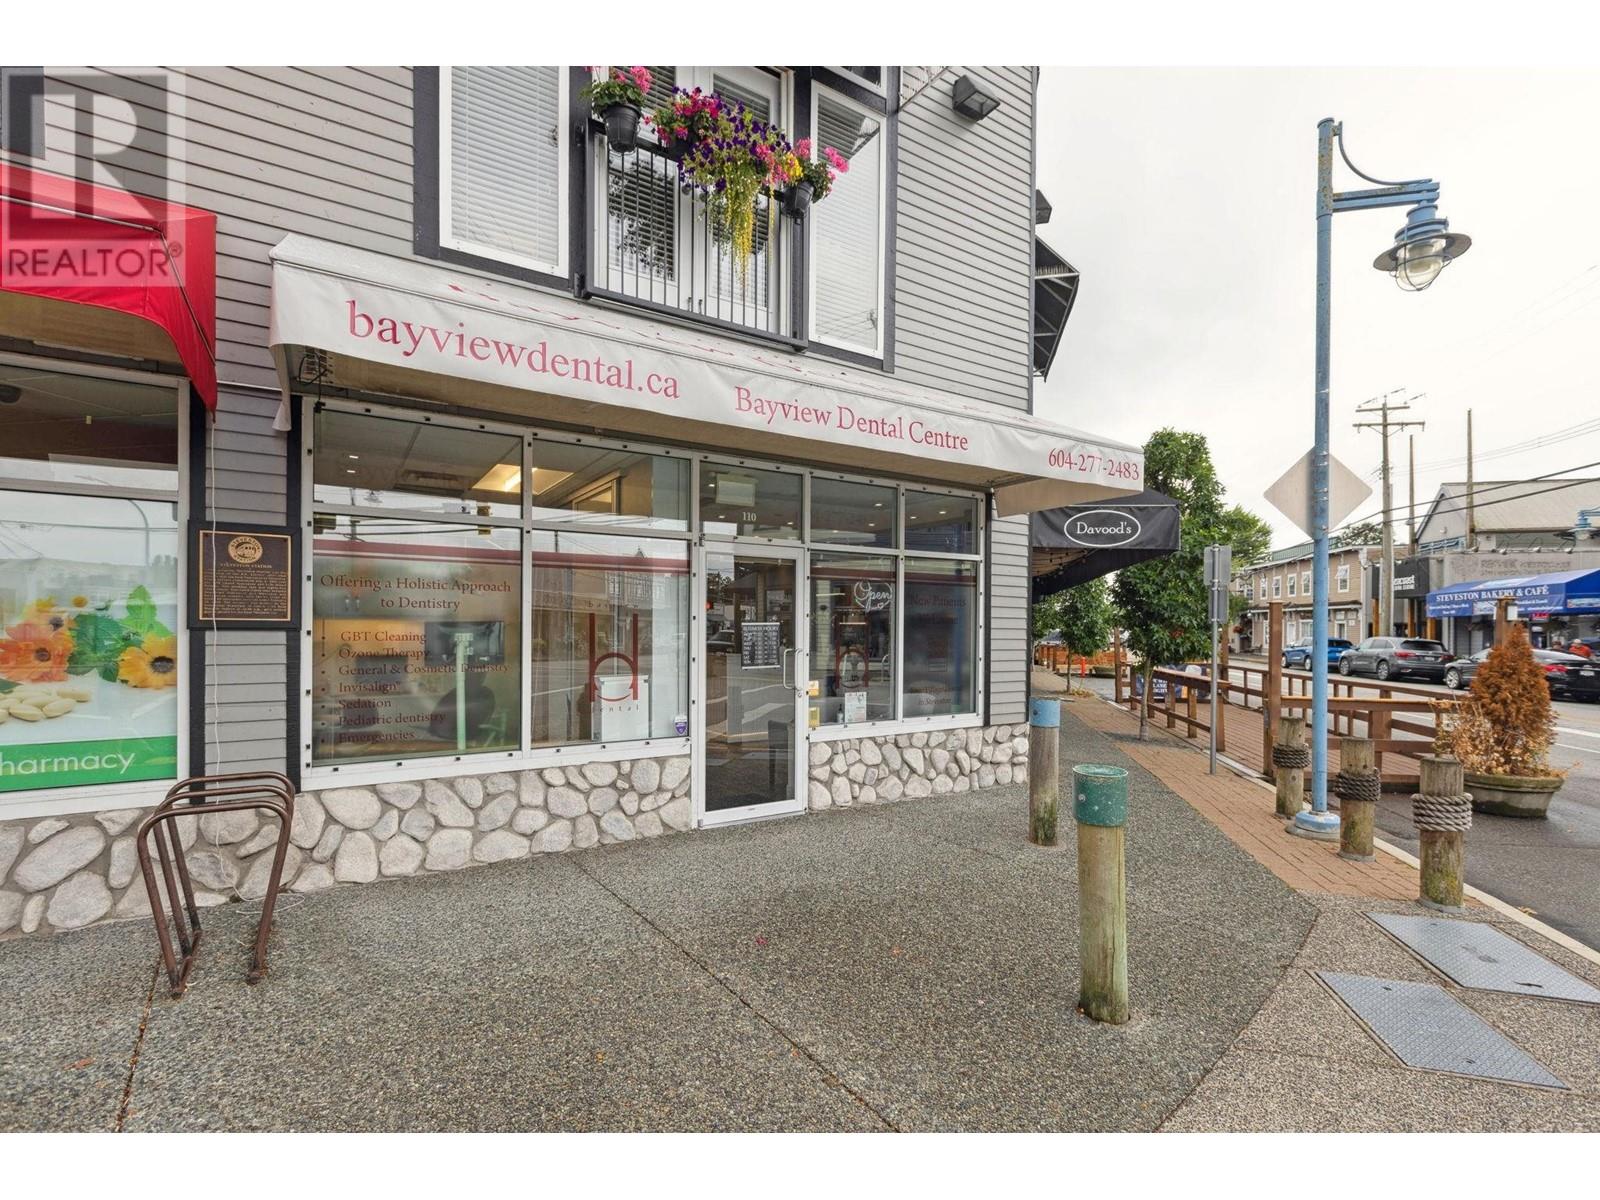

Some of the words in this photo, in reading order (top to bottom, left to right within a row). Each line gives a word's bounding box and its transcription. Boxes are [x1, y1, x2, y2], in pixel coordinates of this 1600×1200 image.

[347, 299, 681, 400] bayviewdental.ca
[735, 386, 832, 424] Bayview
[837, 405, 904, 439] Dental
[909, 421, 969, 451] Centre
[1048, 448, 1139, 480] 604-277-2483
[1076, 521, 1132, 535] Davood's
[320, 574, 381, 591] Offering
[385, 579, 392, 589] a
[396, 577, 448, 590] Holistic
[451, 580, 511, 595] Approach
[1436, 591, 1480, 602] STEVESTON
[1481, 588, 1515, 599] BAKERY
[1516, 587, 1524, 597] &
[380, 598, 394, 608] to
[399, 597, 461, 611] Dentistry
[340, 631, 371, 642] GBT
[374, 631, 426, 644] Cleaning
[338, 648, 381, 659] Ozone
[383, 648, 430, 662] Therapy
[338, 664, 387, 676] General
[390, 664, 401, 675] &
[404, 662, 457, 674] Cosmetic
[338, 698, 392, 709] Sedation
[338, 714, 392, 727] Pediatric
[395, 712, 446, 724] dentistry
[338, 731, 415, 745] Emergencies
